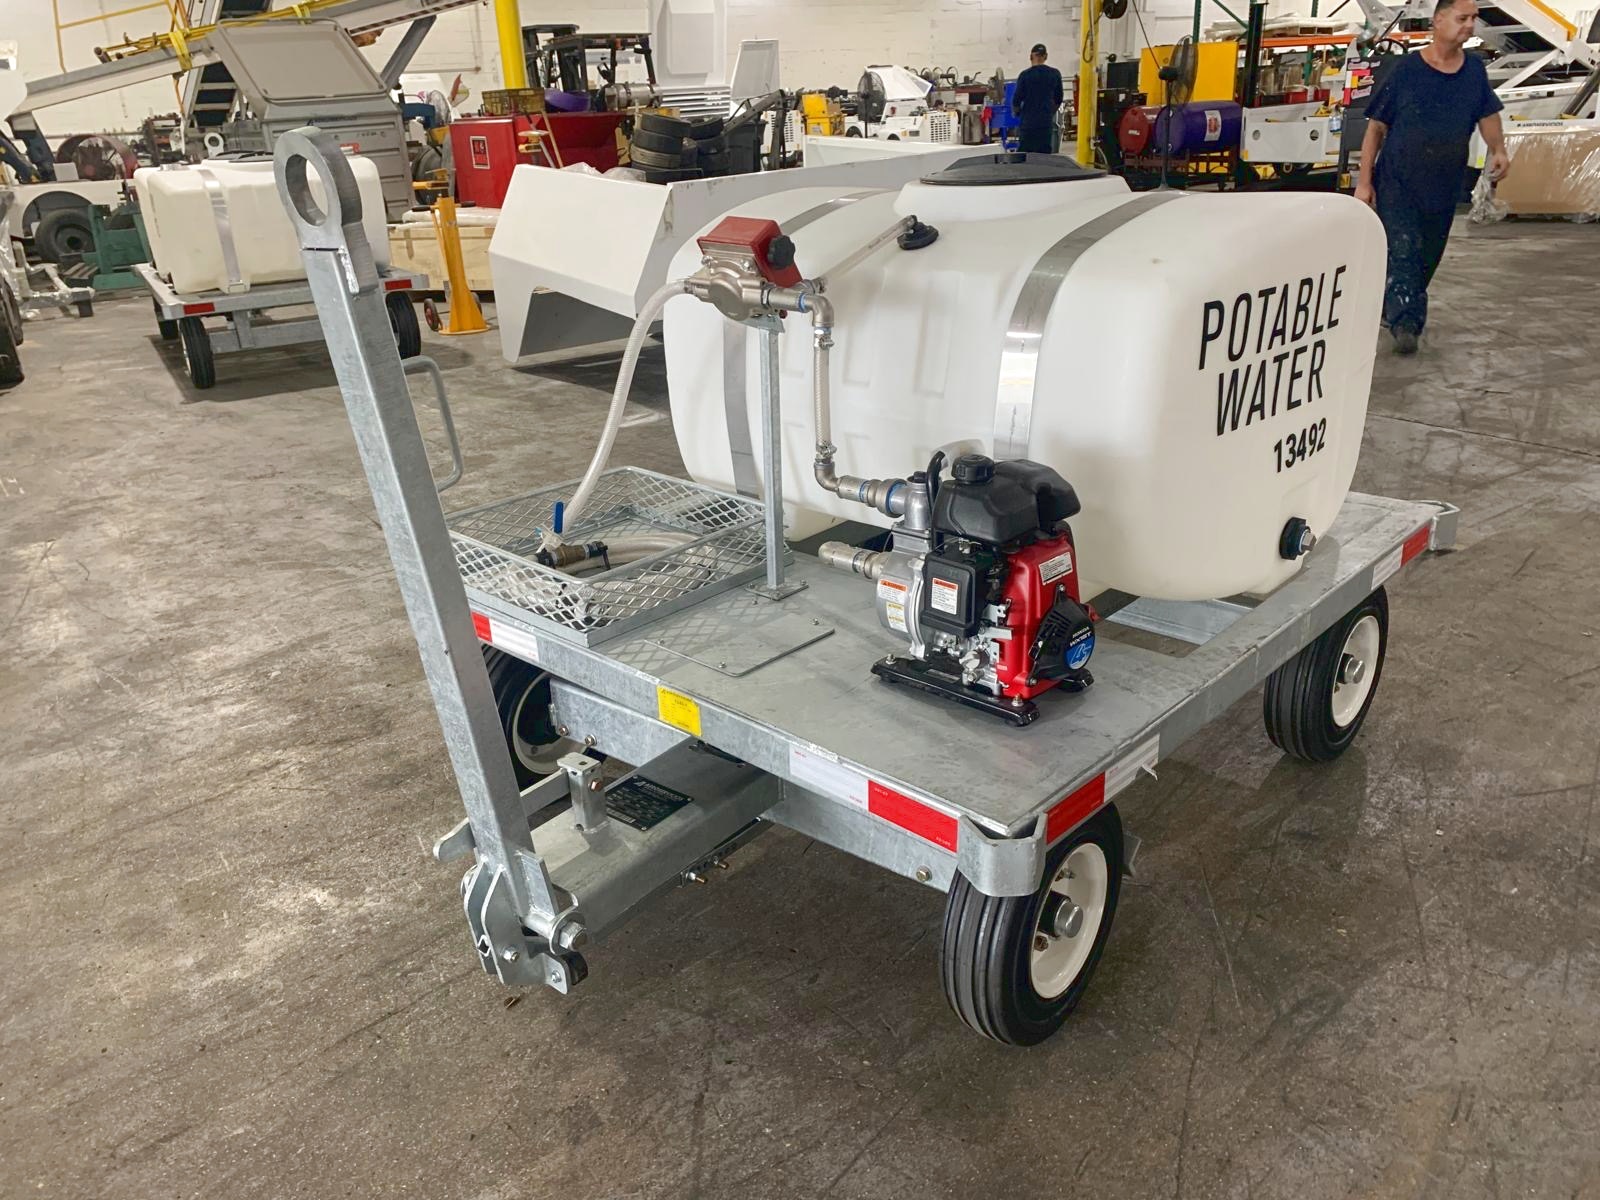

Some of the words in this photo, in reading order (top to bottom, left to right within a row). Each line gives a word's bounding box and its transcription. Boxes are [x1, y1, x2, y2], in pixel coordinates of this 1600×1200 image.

[1199, 265, 1346, 370] POTABLE
[1217, 339, 1326, 436] WATER
[1274, 418, 1327, 473] 13492
